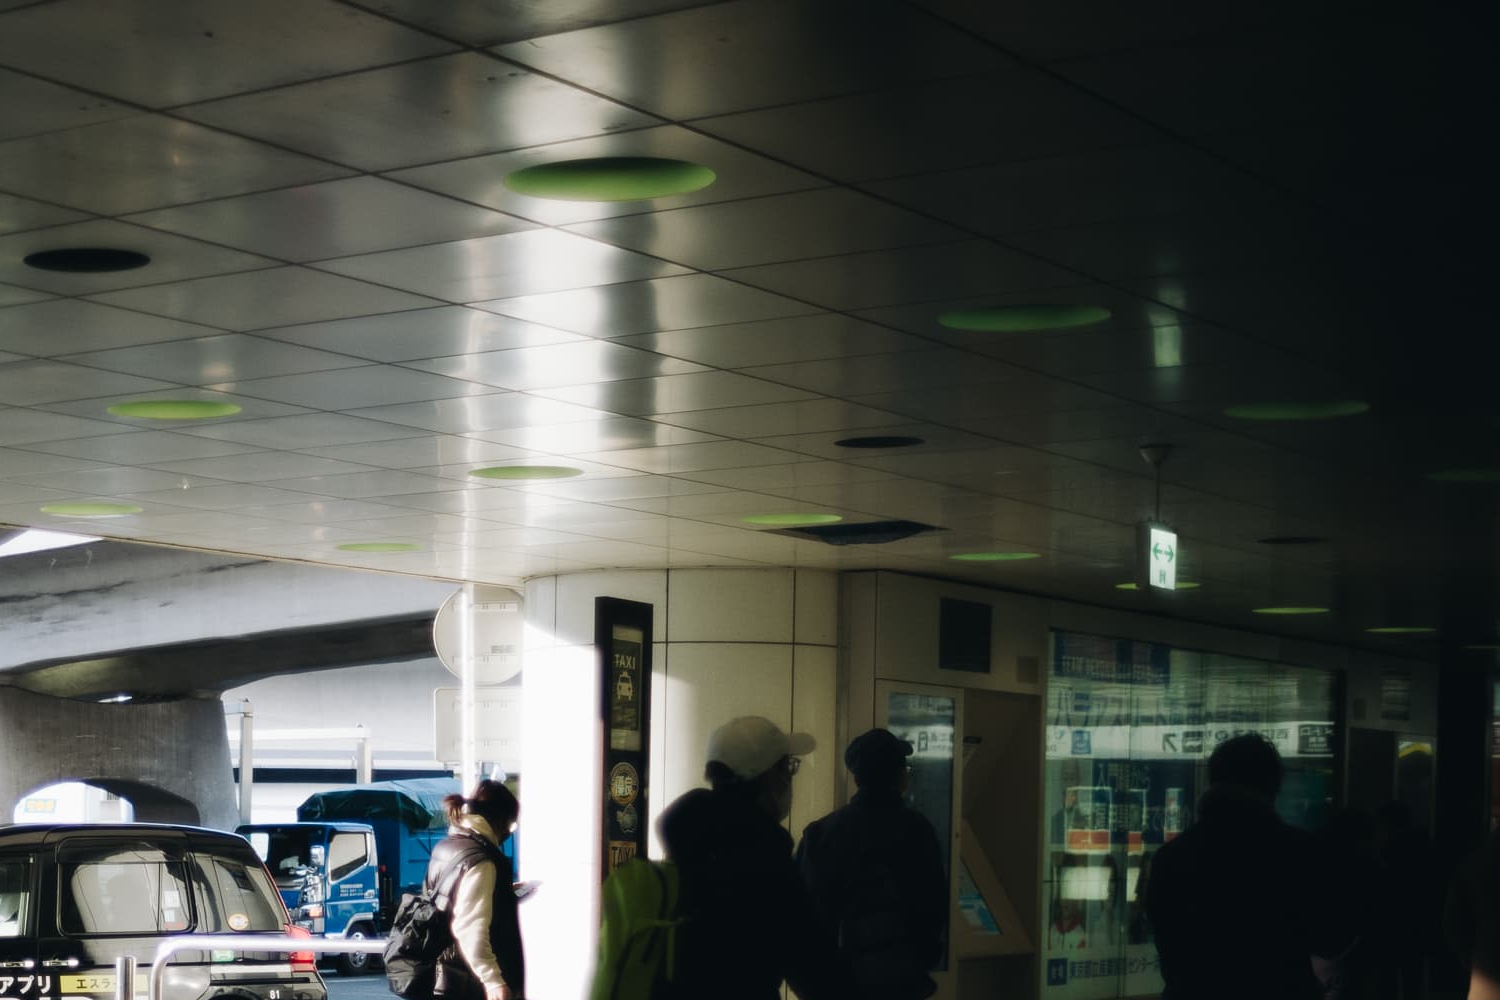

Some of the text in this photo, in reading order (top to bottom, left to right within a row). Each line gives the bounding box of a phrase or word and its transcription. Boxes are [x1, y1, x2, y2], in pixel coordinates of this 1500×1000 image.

[614, 654, 637, 670] TAXI
[76, 977, 117, 990] エスラ
[269, 990, 281, 1000] 81
